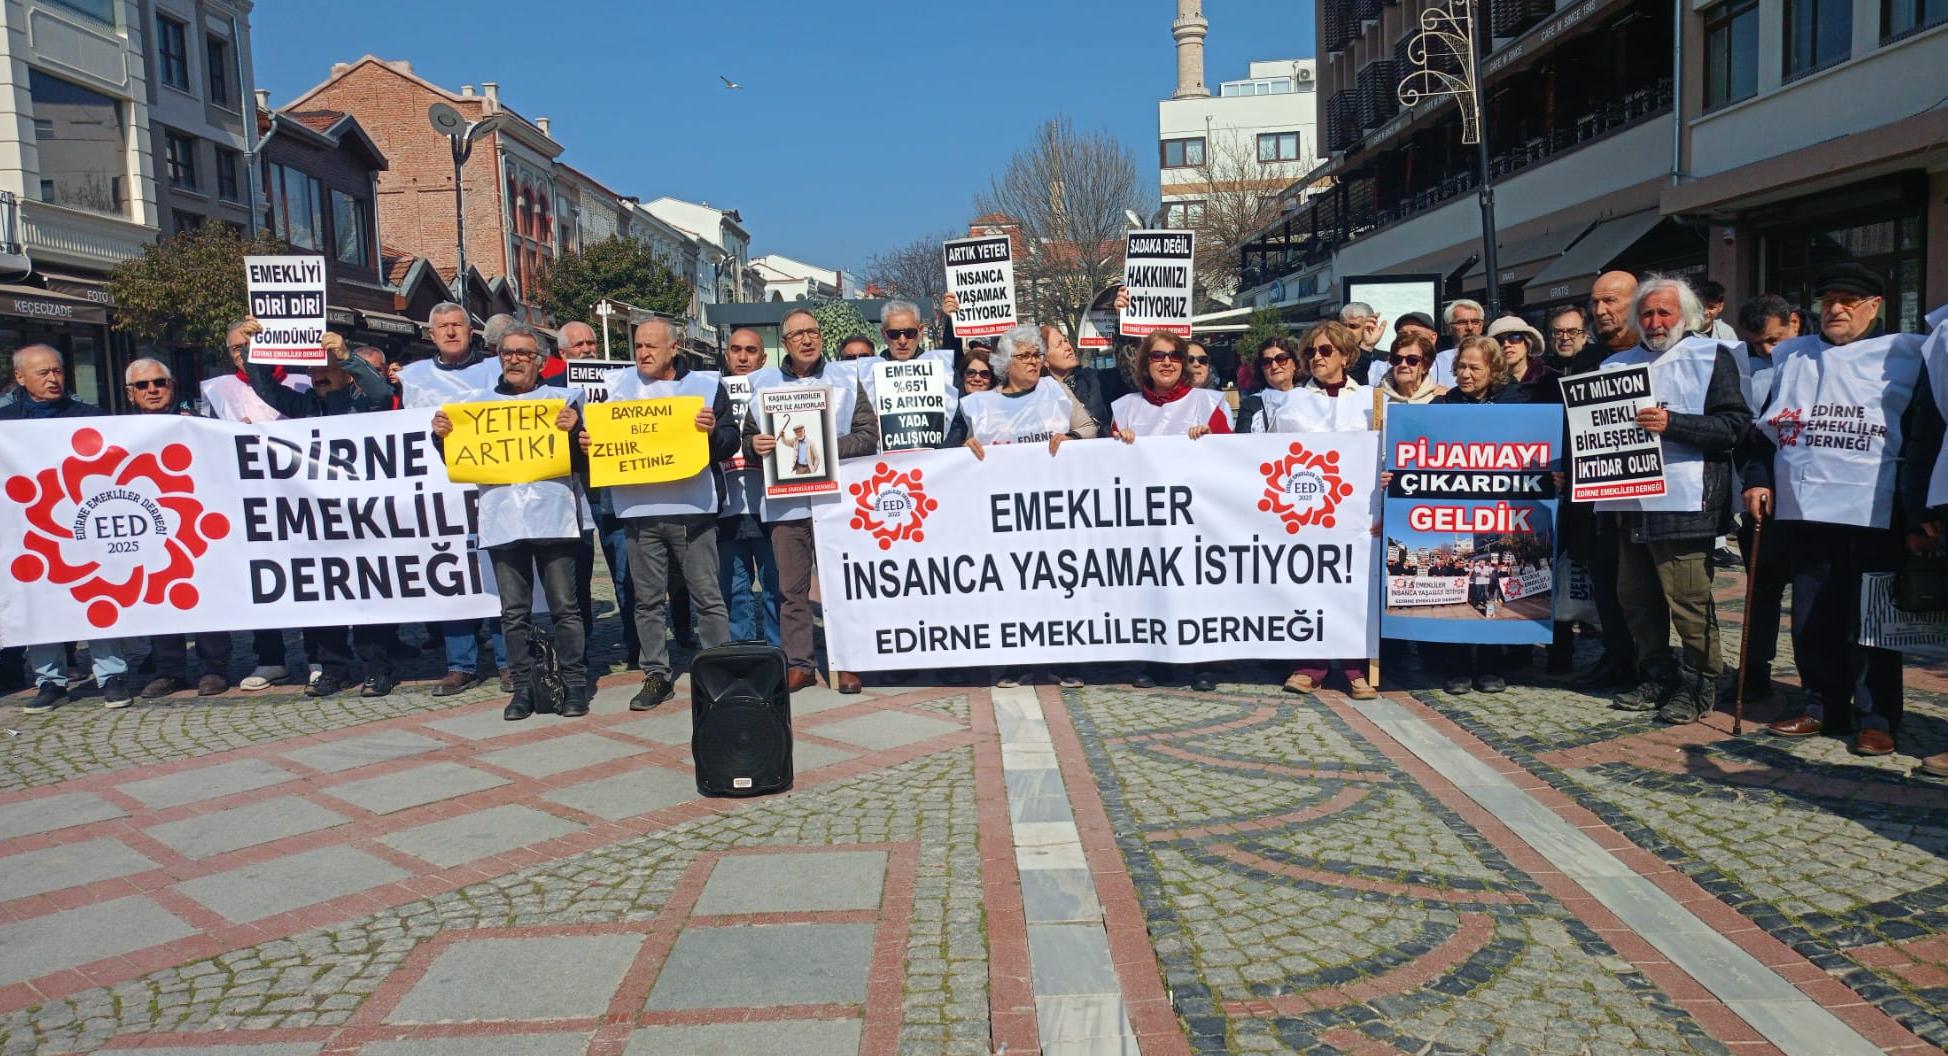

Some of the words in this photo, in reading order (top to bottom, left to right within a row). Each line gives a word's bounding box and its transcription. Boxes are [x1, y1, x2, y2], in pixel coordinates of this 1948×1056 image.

[949, 245, 976, 262] ARTIK
[977, 242, 1007, 259] YETER
[1130, 238, 1161, 254] SADAKA
[1164, 235, 1189, 254] DEĞİL
[249, 259, 322, 284] EMEKLİYİ
[956, 268, 1005, 286] İNSANCA
[1127, 265, 1187, 288] HAKKIMIZI
[87, 290, 108, 303] FOTO
[254, 293, 287, 316] DİRİ
[290, 293, 321, 316] DİRİ
[955, 286, 1008, 306] YAŞAMAK
[1125, 291, 1187, 318] İSTİYORUZ
[14, 299, 73, 318] KEÇECİZADE
[955, 304, 1012, 322] İSTİYORUZ
[255, 327, 323, 345] GÖMDÜNÜZ
[885, 361, 933, 378] EMEKLİ
[793, 391, 821, 401] VERDİLER
[1569, 383, 1585, 402] 17
[1590, 373, 1645, 400] MİLYON
[611, 404, 672, 420] BAYRAMI
[880, 395, 892, 413] İŞ
[896, 395, 944, 409] ARIYOR
[1591, 400, 1638, 427] EMEKLİ
[1811, 402, 1865, 419] EDİRNE
[464, 404, 552, 435] YETER
[631, 422, 659, 435] BİZE
[898, 414, 930, 428] YADA
[1807, 419, 1889, 438] EMEKLİLER
[591, 439, 642, 458] ZEHİR
[884, 430, 942, 450] ÇALIŞIYOR
[1575, 427, 1655, 452] BİRLEŞEREK
[1805, 434, 1872, 452] DERNEĞİ
[233, 428, 429, 481] EDİRNE
[455, 433, 556, 467] ARTIK!
[1396, 437, 1550, 469] PİJAMAYI
[618, 453, 676, 473] ETTİNİZ
[1578, 455, 1624, 479] İKTİDAR
[1627, 453, 1660, 474] OLUR
[1294, 482, 1318, 494] EED
[1399, 473, 1543, 496] ÇIKARDIK
[1600, 486, 1634, 497] EMEKLİLER
[1635, 483, 1662, 494] DERNEĞİ
[73, 507, 91, 541] EDİRNE
[85, 488, 141, 510] EMEKLİLER
[883, 499, 904, 511] EED
[990, 477, 1194, 533] EMEKLİLER
[94, 514, 148, 539] EED
[1409, 502, 1532, 533] GELDİK
[107, 540, 139, 554] 2025
[250, 539, 485, 604] DERNEĞİ
[842, 552, 1004, 601] İNSANCA
[1009, 546, 1185, 599] YAŞAMAK
[1195, 534, 1353, 585] İSTİYOR!
[875, 620, 991, 655] EDİRNE
[1001, 611, 1168, 649] EMEKLİLER
[1177, 609, 1324, 646] DERNEĞİ
